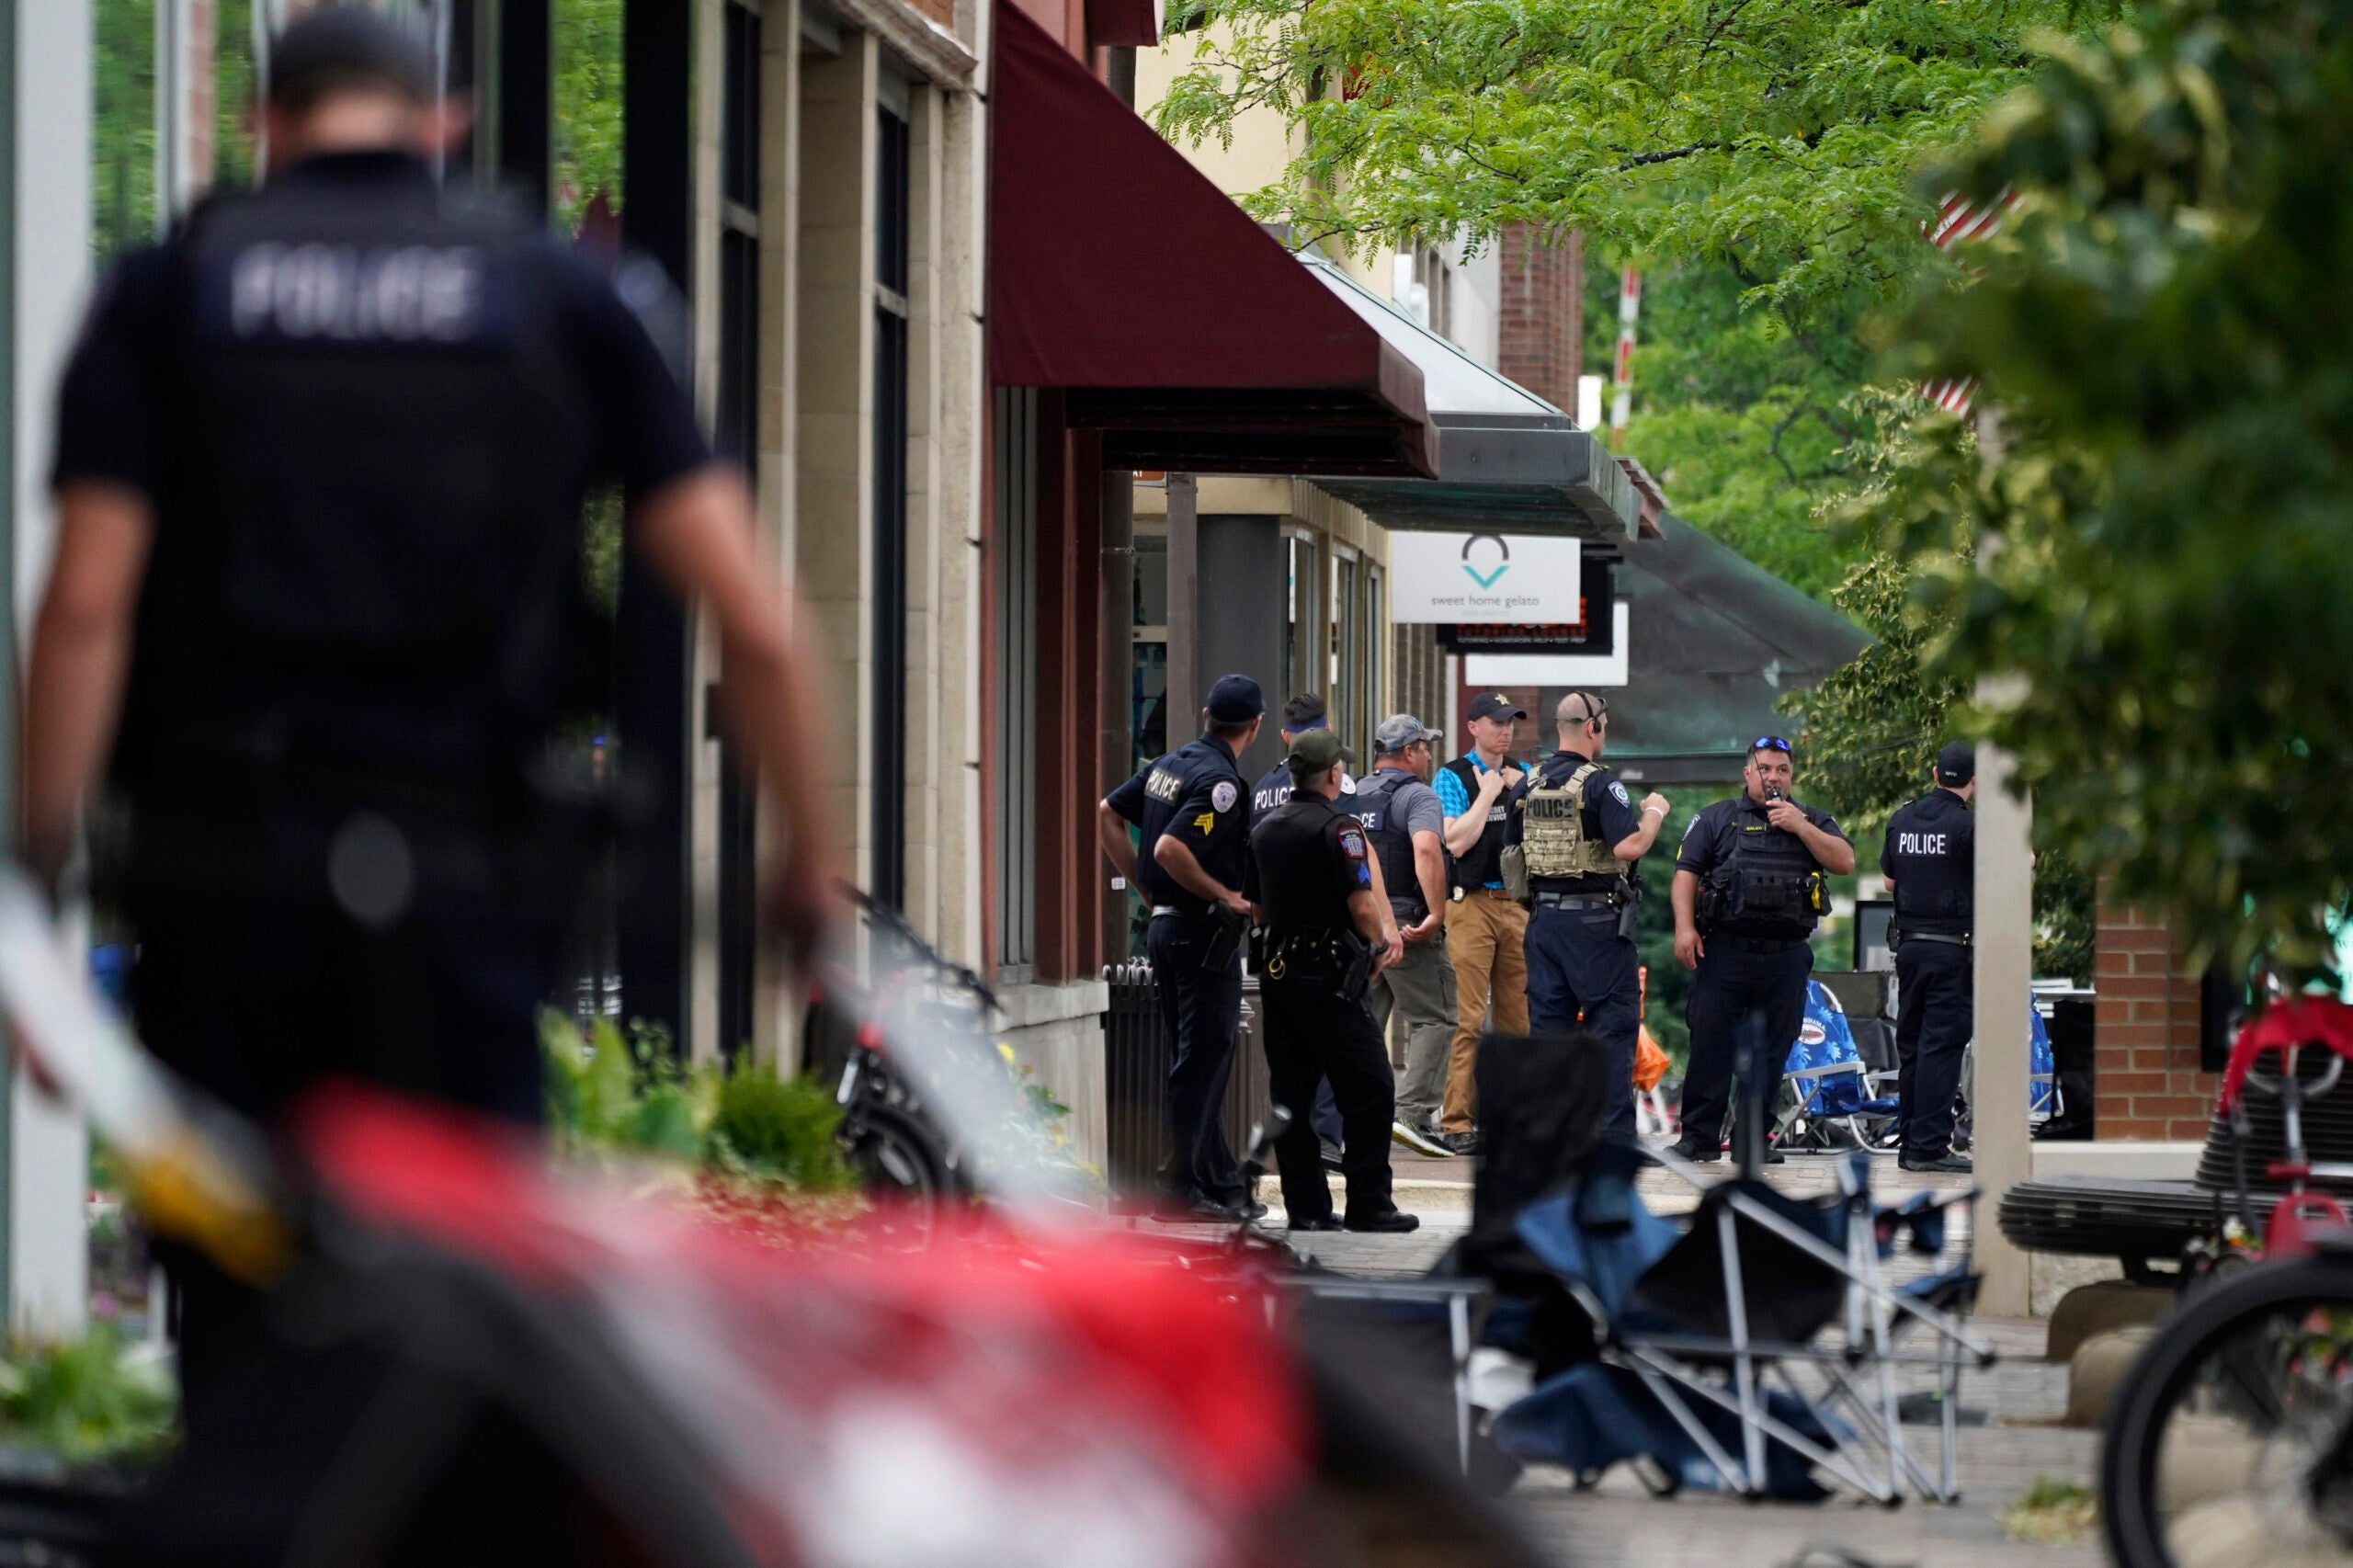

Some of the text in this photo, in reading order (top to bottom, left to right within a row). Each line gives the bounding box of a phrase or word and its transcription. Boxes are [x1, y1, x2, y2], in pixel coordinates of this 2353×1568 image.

[233, 245, 480, 336] POLICE
[1431, 595, 1540, 608] sweet home gelato
[1145, 769, 1181, 801] POLICE
[1526, 798, 1574, 818] POLICE
[1898, 832, 1947, 855] POLICE
